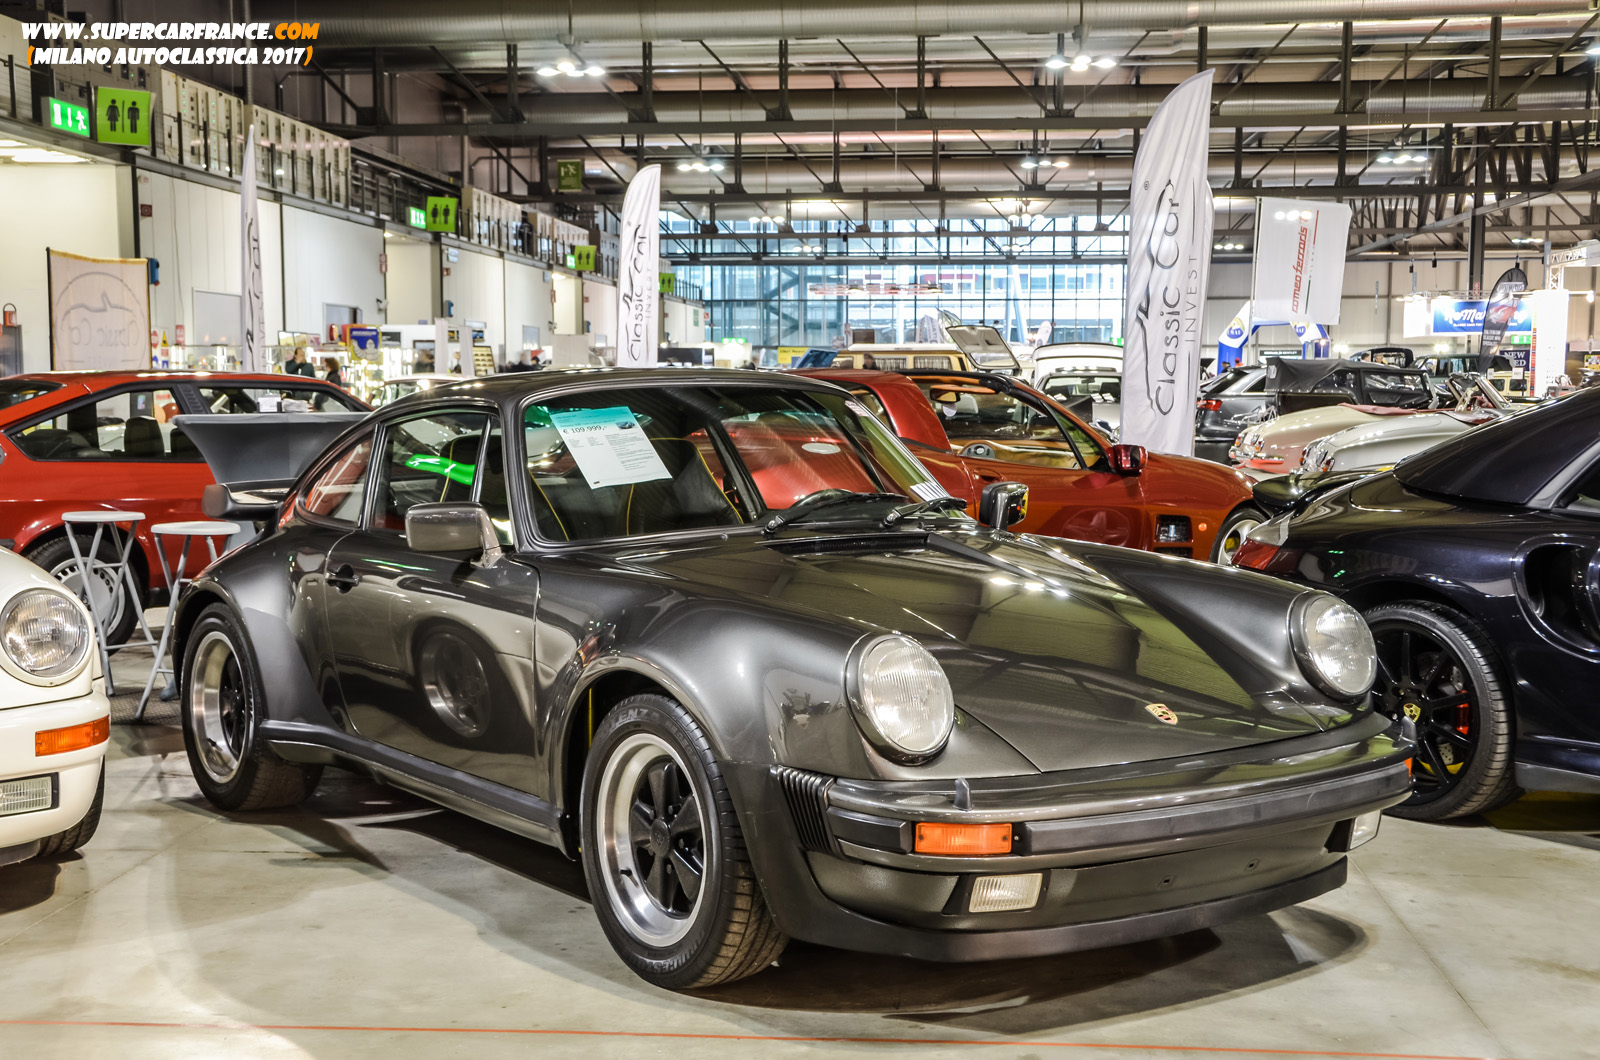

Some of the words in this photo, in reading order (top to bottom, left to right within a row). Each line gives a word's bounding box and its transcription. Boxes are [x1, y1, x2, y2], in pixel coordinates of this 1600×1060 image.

[633, 235, 647, 274] Car
[1155, 198, 1179, 269] Car
[1292, 226, 1308, 275] ferraris
[630, 285, 644, 361] Classic
[1185, 255, 1198, 342] INVEST
[1291, 275, 1302, 314] romeo
[1155, 286, 1180, 416] Classic
